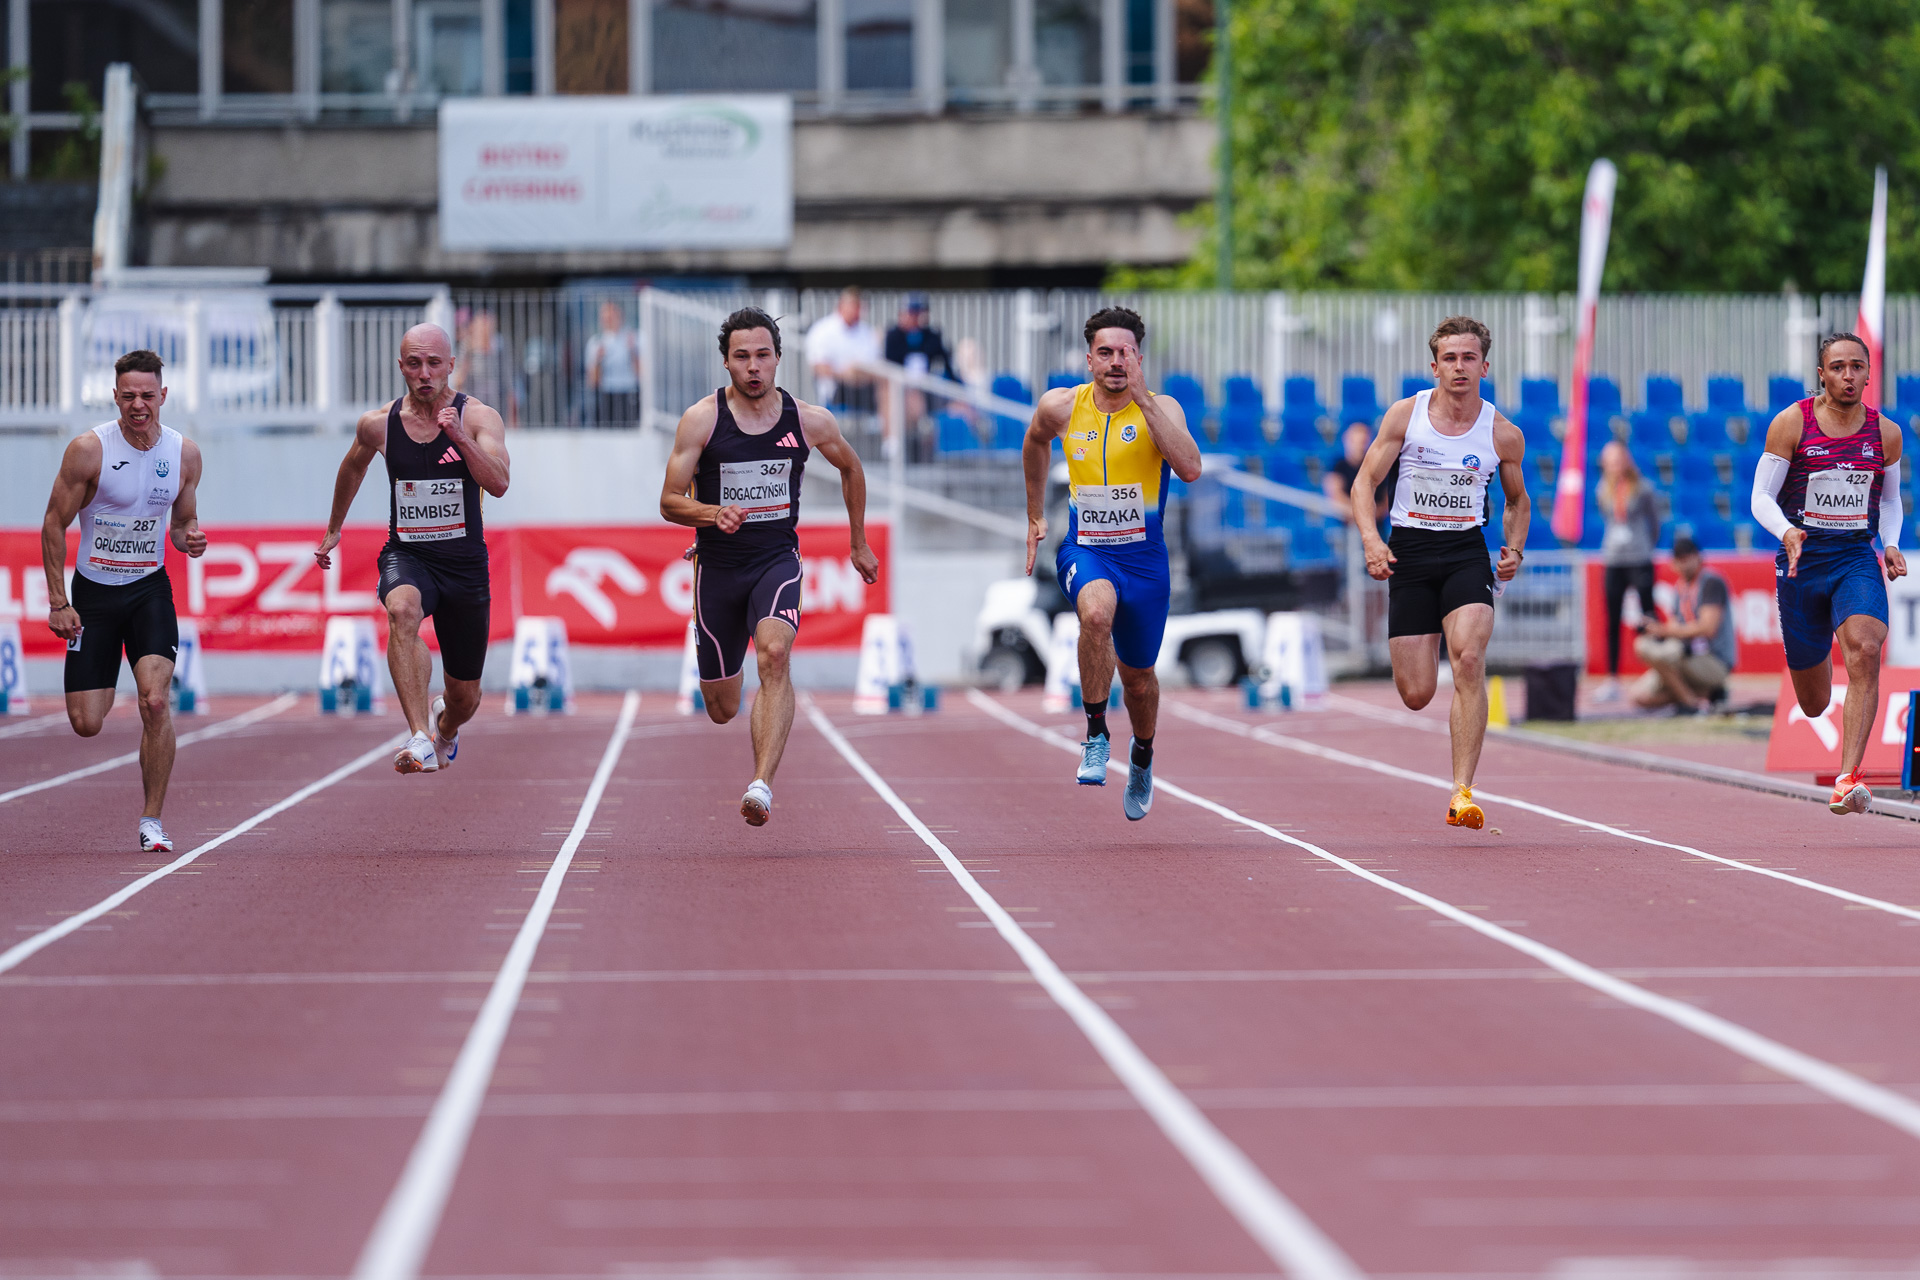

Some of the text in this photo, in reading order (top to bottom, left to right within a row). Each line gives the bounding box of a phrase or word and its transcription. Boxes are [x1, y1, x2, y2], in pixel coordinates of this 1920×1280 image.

[760, 463, 786, 476] 367
[1450, 474, 1473, 486] 366
[1846, 474, 1868, 484] 422
[430, 482, 456, 495] 252
[723, 482, 787, 500] BOGACZYŃSKI
[1112, 488, 1137, 500] 356
[1414, 492, 1472, 508] WRÓBEL
[1814, 492, 1864, 508] YAMAH
[400, 503, 460, 520] REMBISZ
[1082, 508, 1140, 526] GRZĄKA
[132, 520, 156, 531] 287
[94, 537, 156, 554] OPUSZEWICZ
[0, 640, 18, 690] 8
